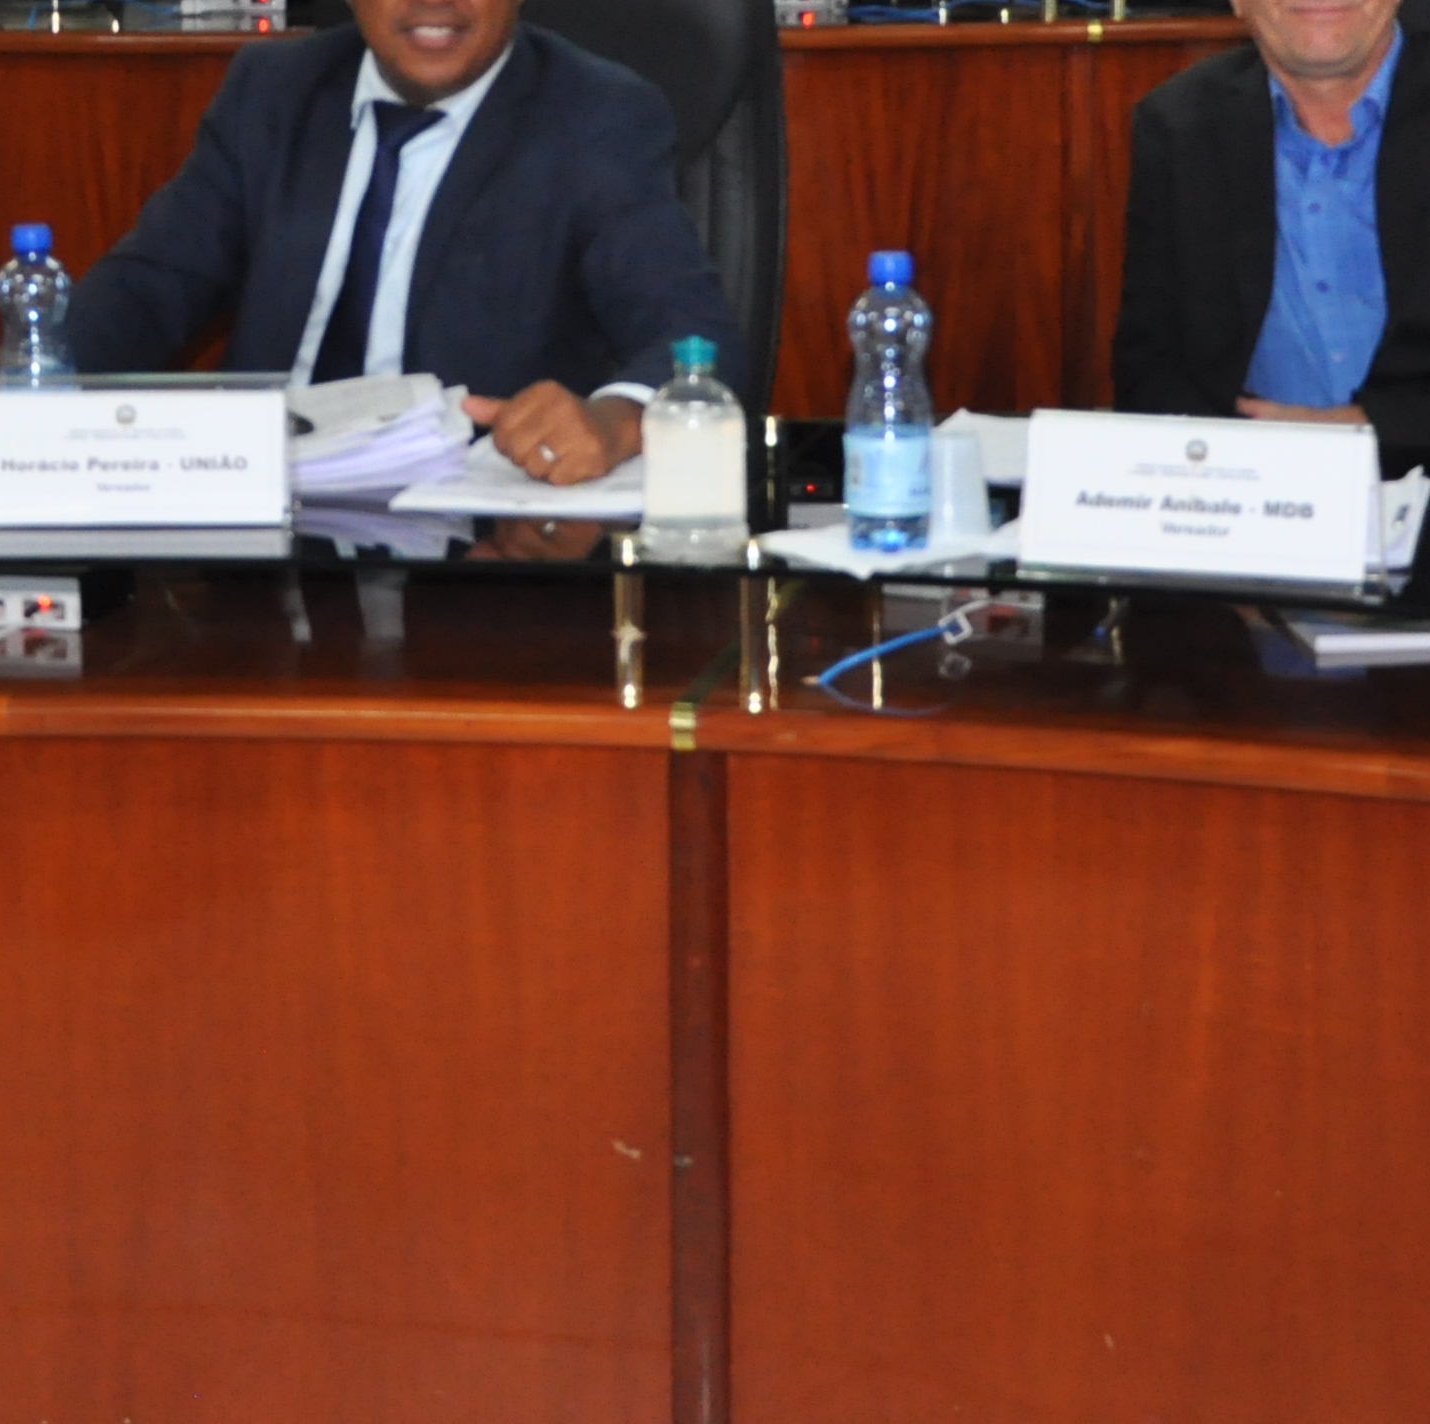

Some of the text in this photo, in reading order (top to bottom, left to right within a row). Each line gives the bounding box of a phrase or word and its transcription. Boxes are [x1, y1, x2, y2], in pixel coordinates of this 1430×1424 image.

[87, 455, 160, 473] Pereira
[1075, 490, 1153, 510] Ademir
[1160, 494, 1242, 516] Anibale
[1262, 501, 1314, 519] MDB
